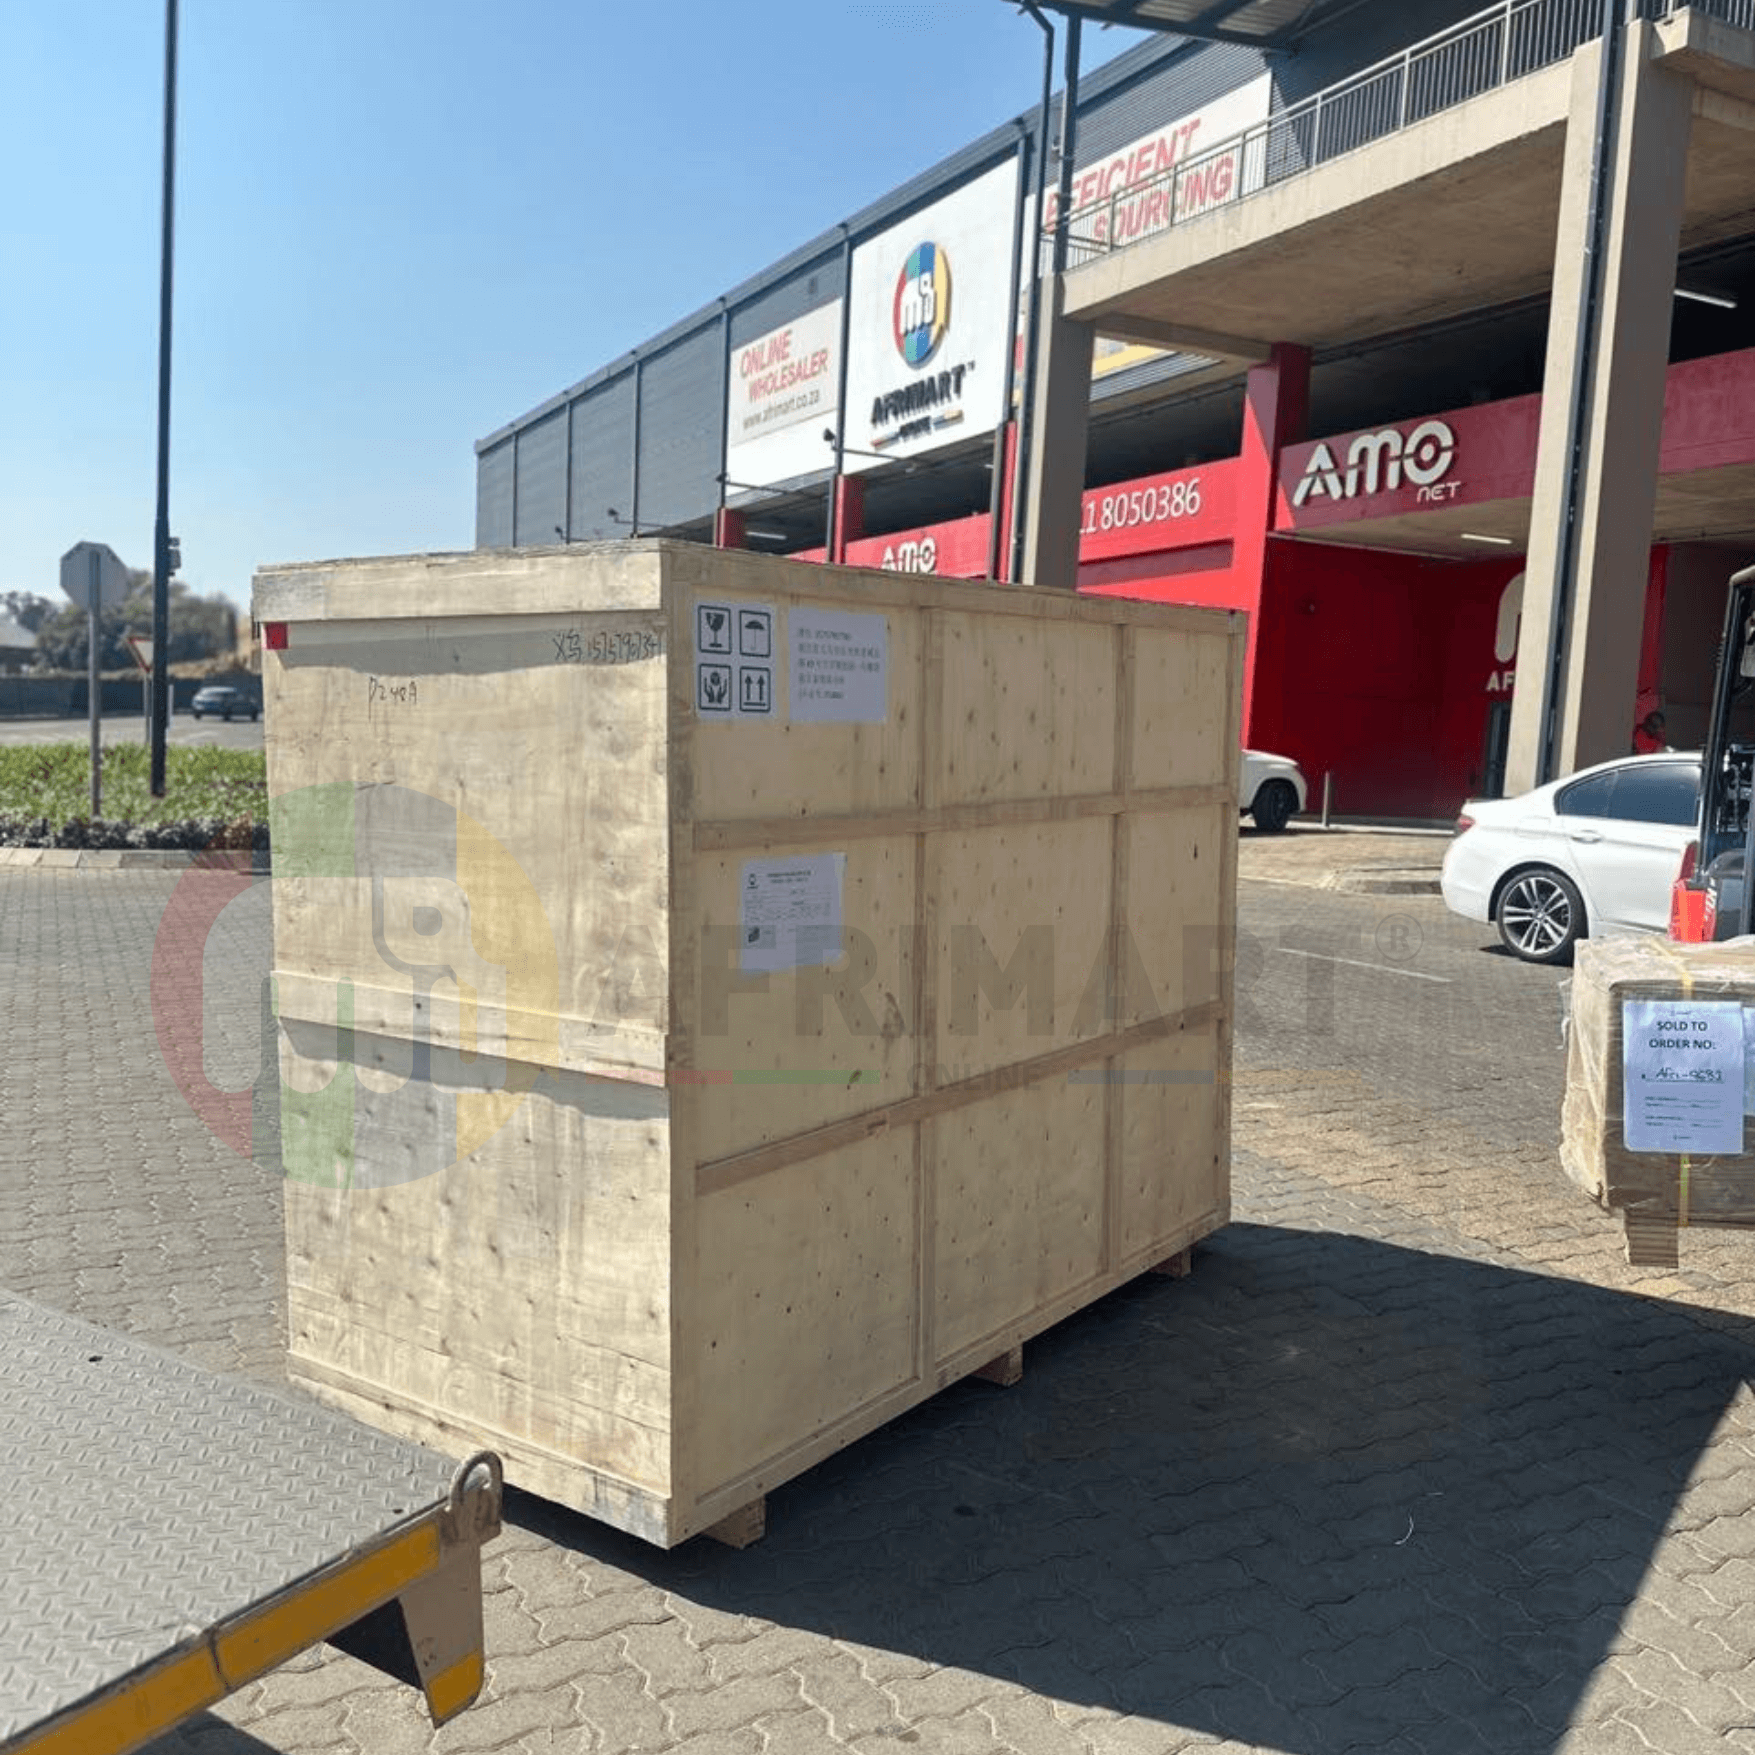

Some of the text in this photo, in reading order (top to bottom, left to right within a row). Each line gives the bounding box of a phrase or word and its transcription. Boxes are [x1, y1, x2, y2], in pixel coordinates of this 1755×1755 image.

[740, 329, 791, 379] ONLINE
[748, 347, 828, 404] WHOLESALER
[1292, 420, 1454, 507] AMO
[1101, 478, 1201, 530] 8050386
[880, 536, 937, 574] AMO
[1648, 1038, 1691, 1049] ORDER
[1656, 1020, 1708, 1032] SOLD TO
